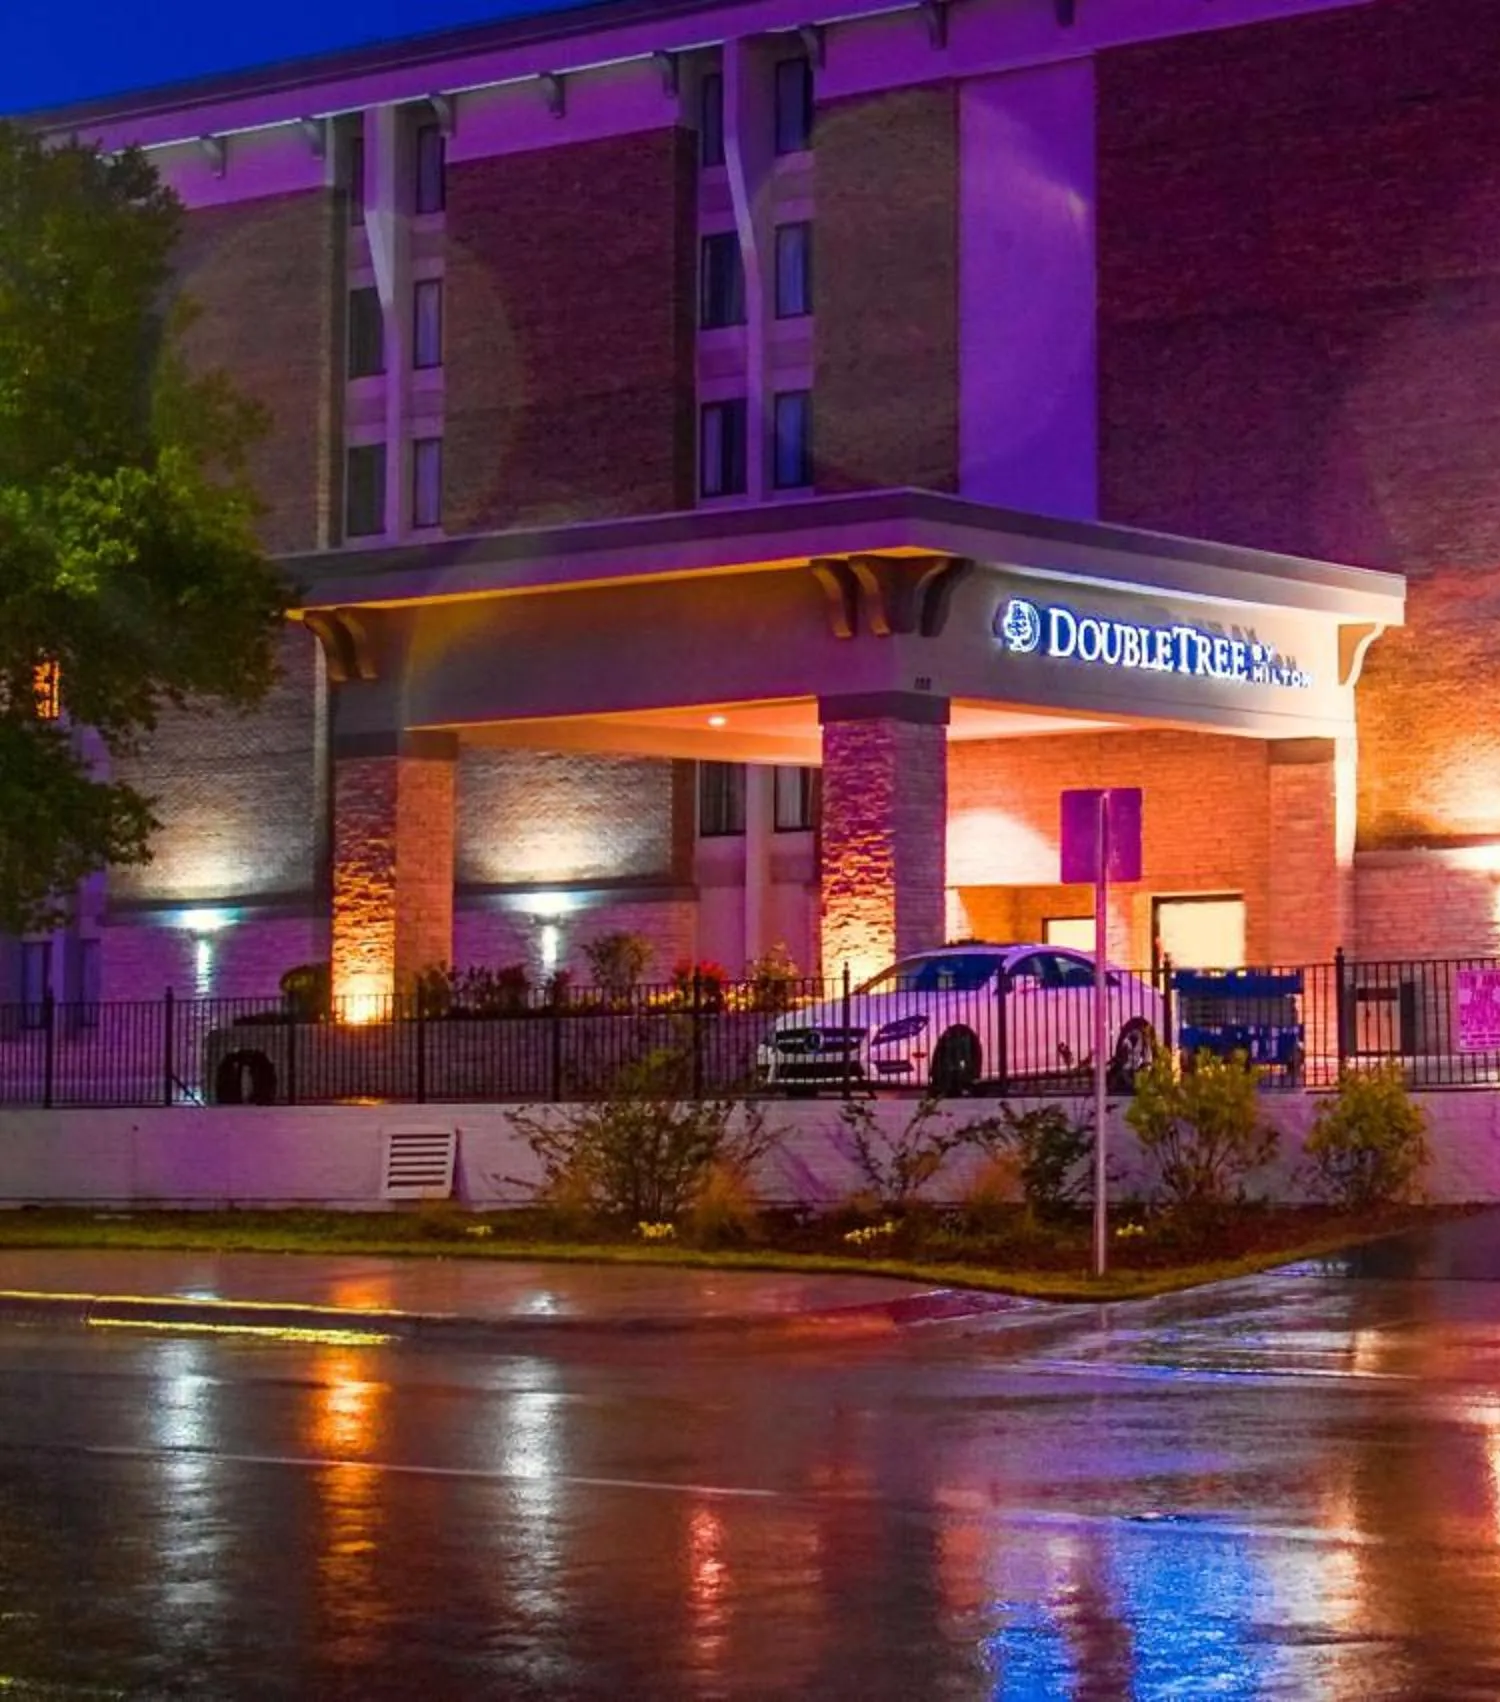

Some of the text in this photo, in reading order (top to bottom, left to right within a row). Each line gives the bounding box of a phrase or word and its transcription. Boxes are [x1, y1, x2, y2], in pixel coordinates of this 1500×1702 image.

[1048, 607, 1249, 681] DOUBLETREE
[1251, 642, 1273, 664] BY
[1252, 665, 1313, 689] HILTON
